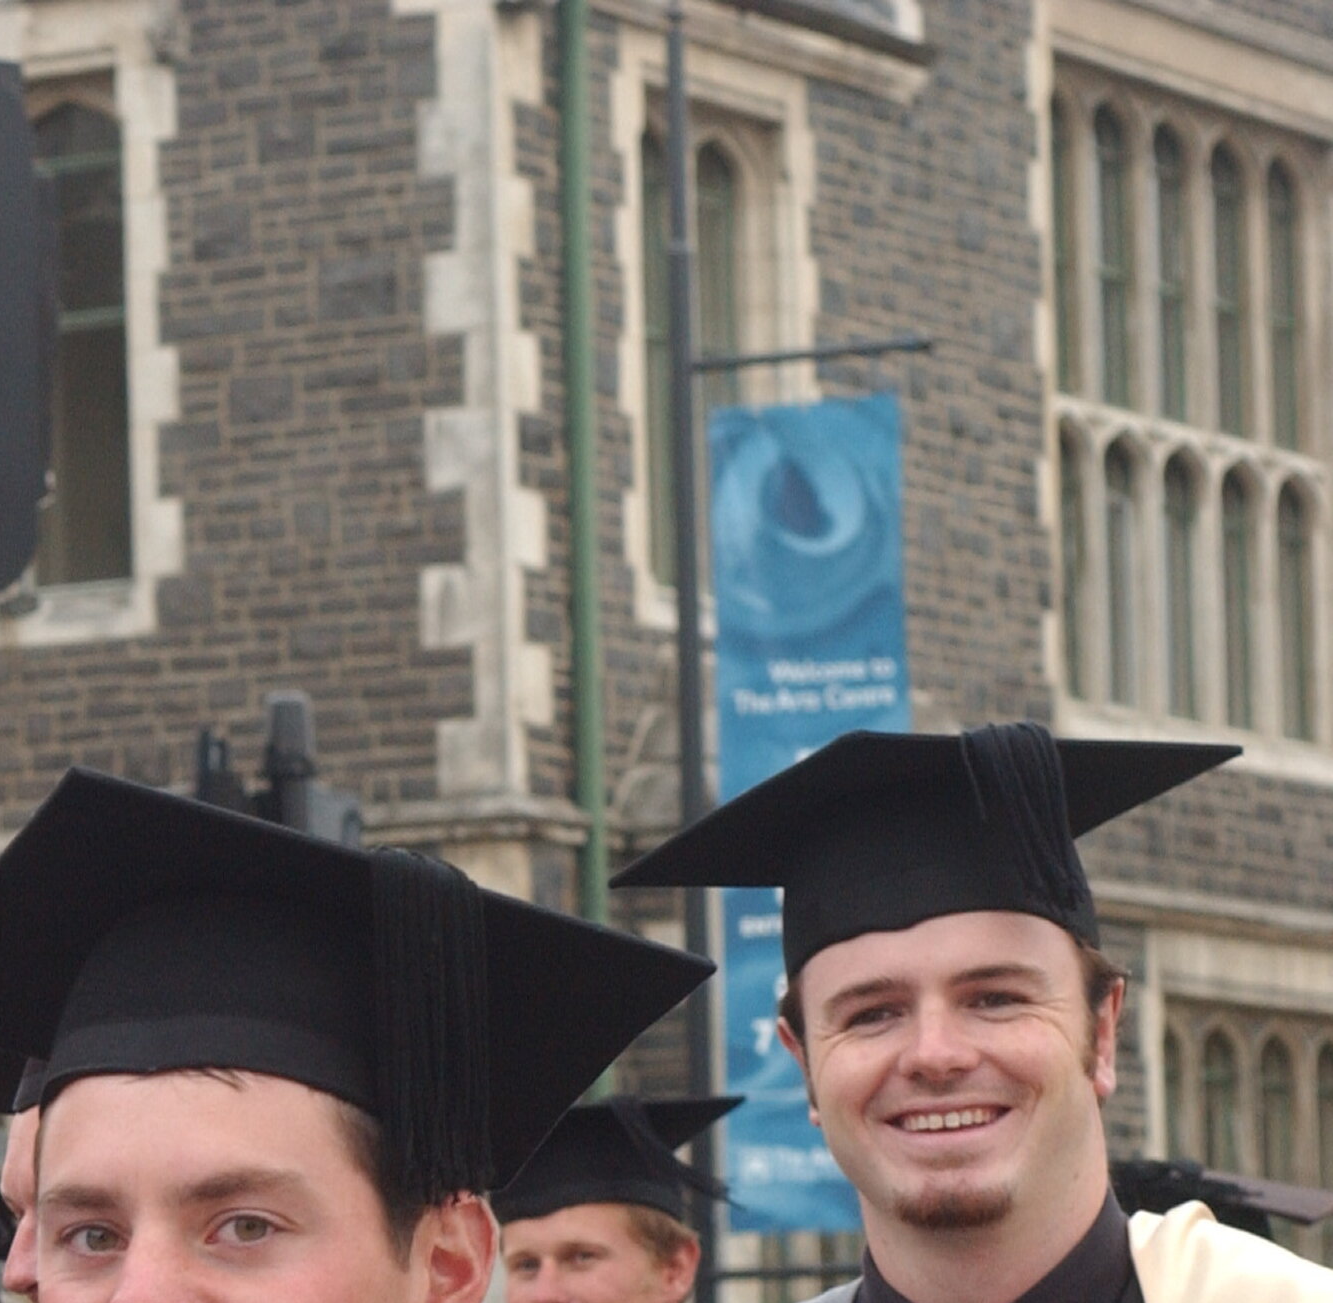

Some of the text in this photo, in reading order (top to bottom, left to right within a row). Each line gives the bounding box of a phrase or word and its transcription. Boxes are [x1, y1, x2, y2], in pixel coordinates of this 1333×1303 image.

[769, 657, 896, 683] Welcome to
[734, 684, 896, 714] The Arts Centre
